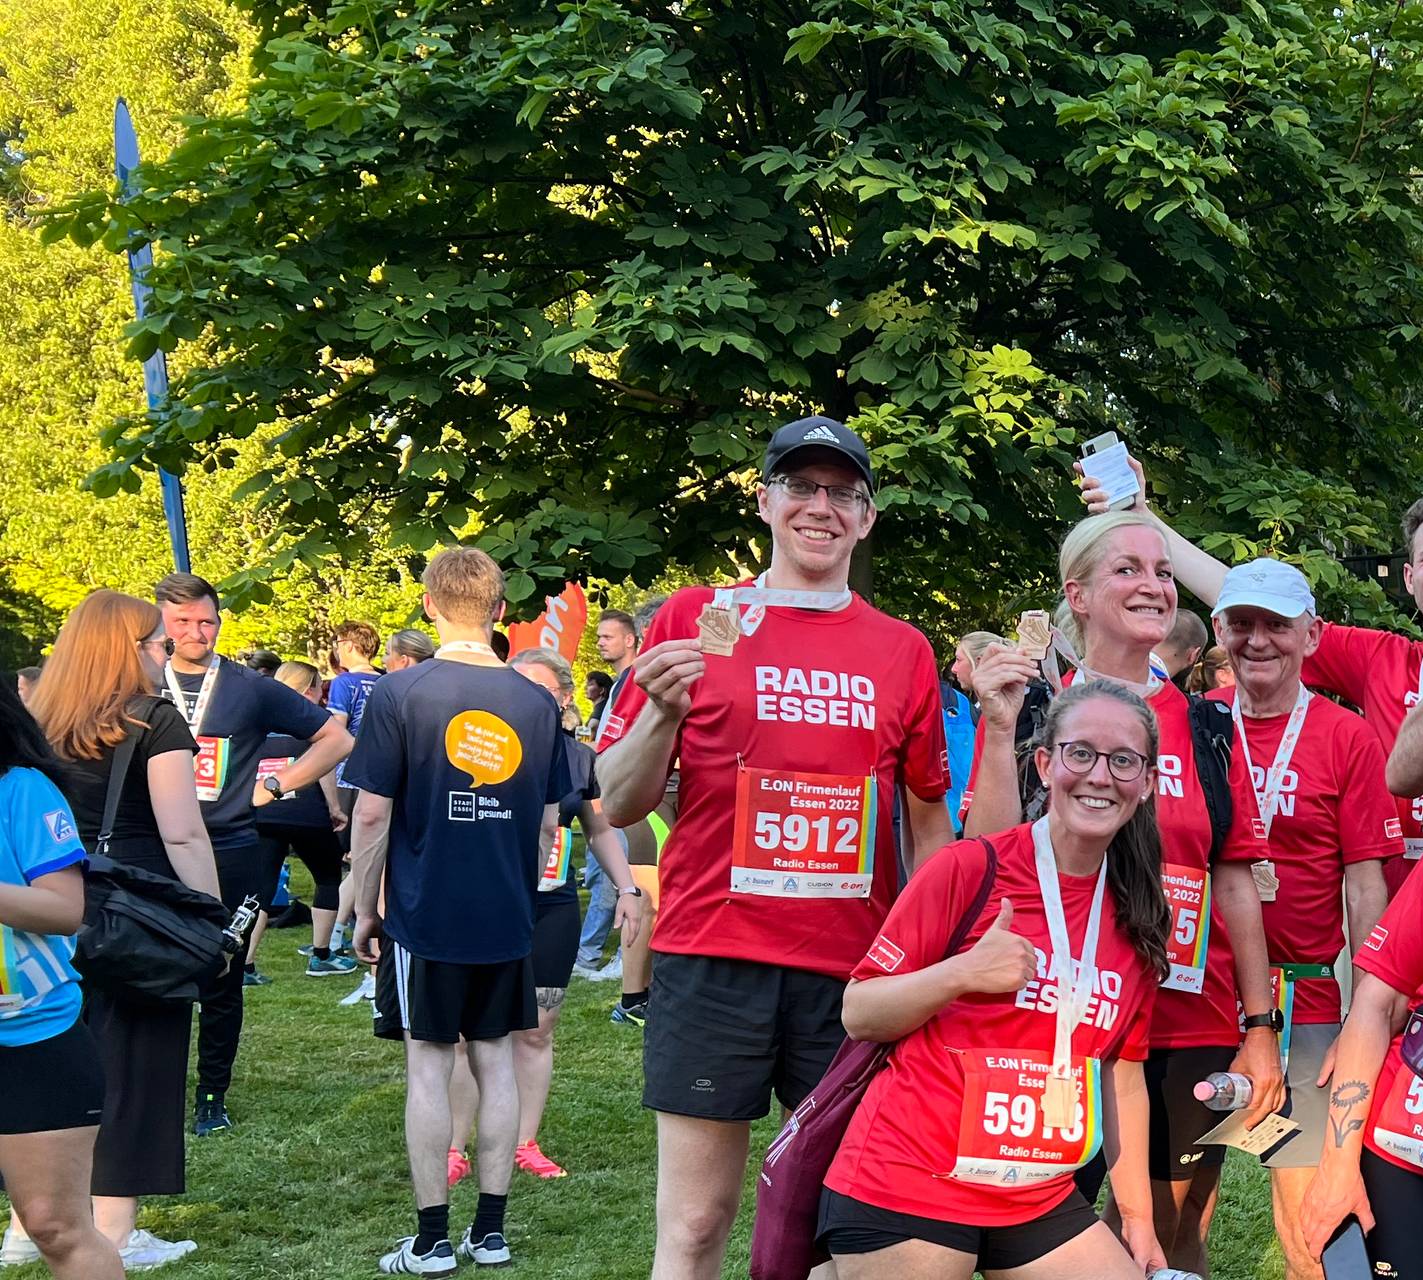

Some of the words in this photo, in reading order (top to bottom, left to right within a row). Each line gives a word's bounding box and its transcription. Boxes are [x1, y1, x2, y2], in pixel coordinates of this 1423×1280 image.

[803, 433, 840, 444] adidas
[755, 666, 875, 701] RADIO
[756, 694, 876, 730] ESSEN
[760, 778, 793, 793] E.ON
[796, 782, 861, 797] Firmenlauf
[478, 797, 499, 807] Bleib
[790, 796, 826, 809] Essen
[829, 799, 859, 811] 2022
[478, 809, 512, 819] gesund!
[754, 811, 859, 853] 5912
[773, 858, 805, 868] Radio
[808, 860, 839, 870] Essen
[1173, 888, 1201, 904] 2022
[1015, 981, 1119, 1031] ESEN
[985, 1056, 1019, 1070] E.ON
[1021, 1059, 1083, 1077] Firmuf
[1018, 1074, 1045, 1088] Esse
[982, 1091, 1084, 1142] 593
[999, 1144, 1030, 1157] Radio
[1032, 1148, 1063, 1160] Essen
